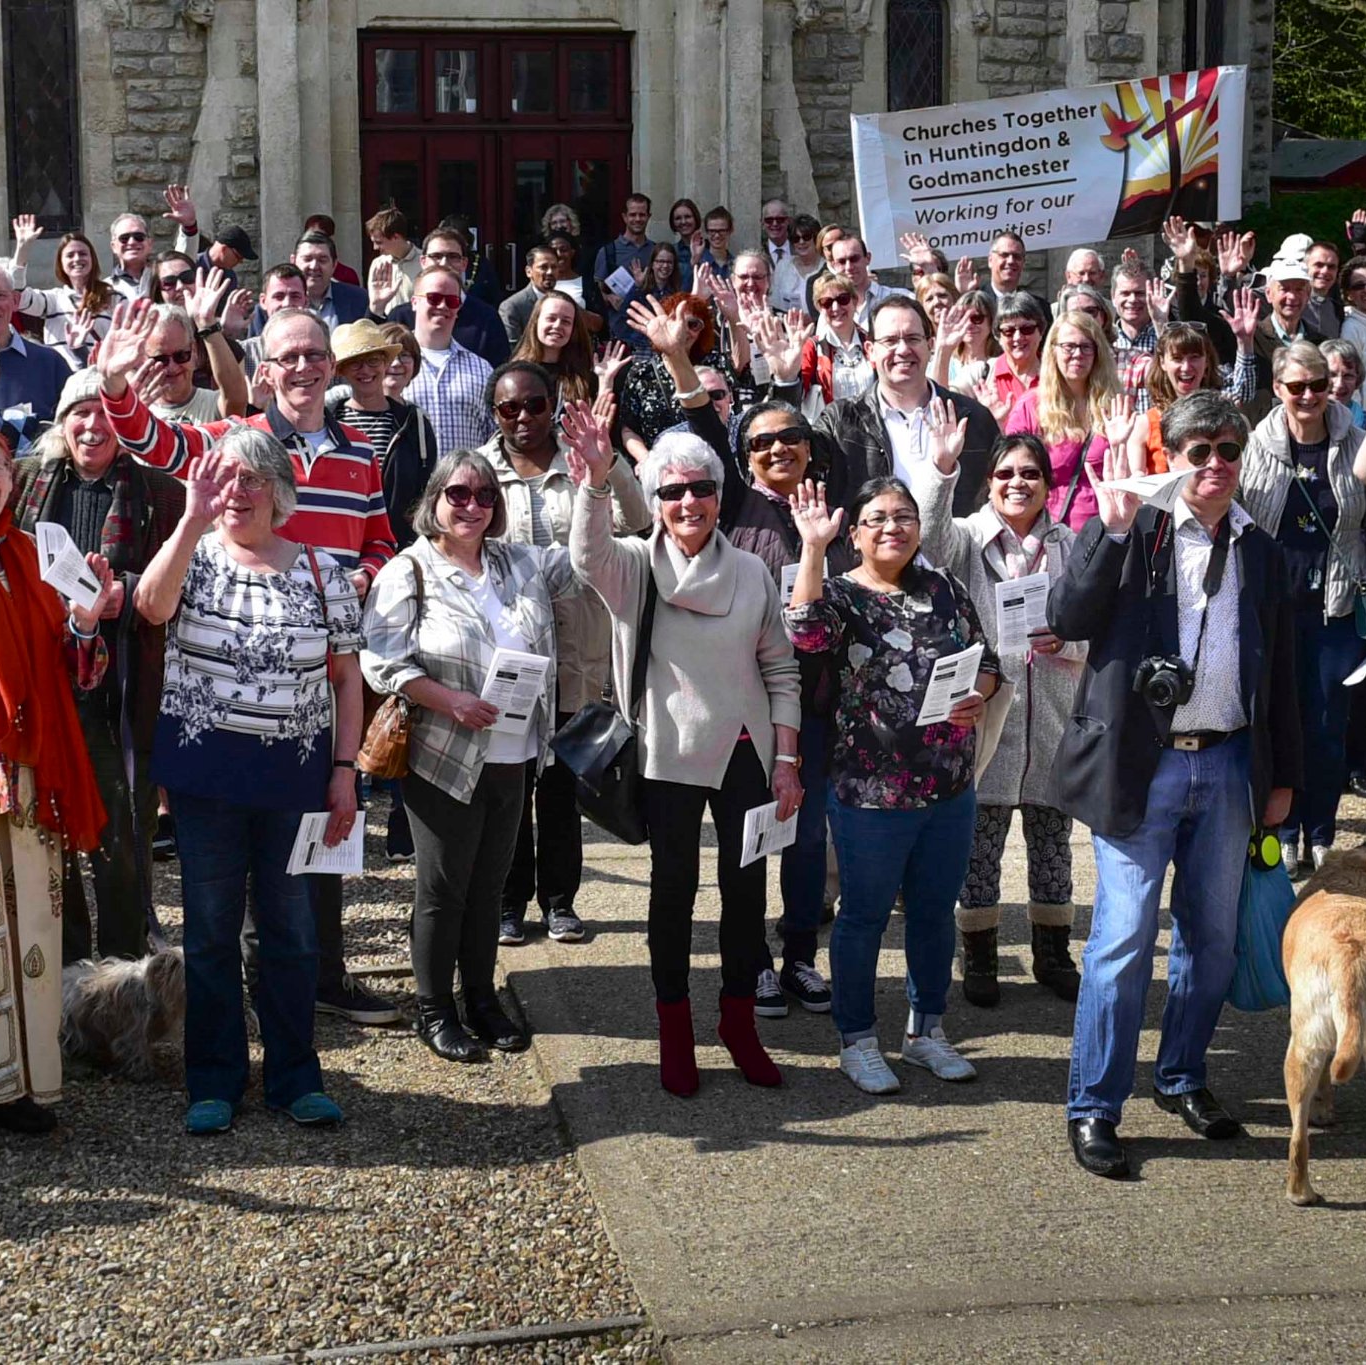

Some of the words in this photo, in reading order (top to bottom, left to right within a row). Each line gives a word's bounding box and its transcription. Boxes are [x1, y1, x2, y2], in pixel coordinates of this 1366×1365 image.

[902, 118, 997, 142] Churches
[1002, 104, 1097, 129] Together
[904, 150, 923, 167] in
[929, 135, 1051, 164] Huntingdon
[1057, 130, 1071, 148] &
[908, 159, 1071, 190] Godmanchester
[914, 202, 998, 226] Working
[1006, 197, 1035, 215] for
[1041, 193, 1075, 210] our
[928, 218, 1052, 249] ommunities!
